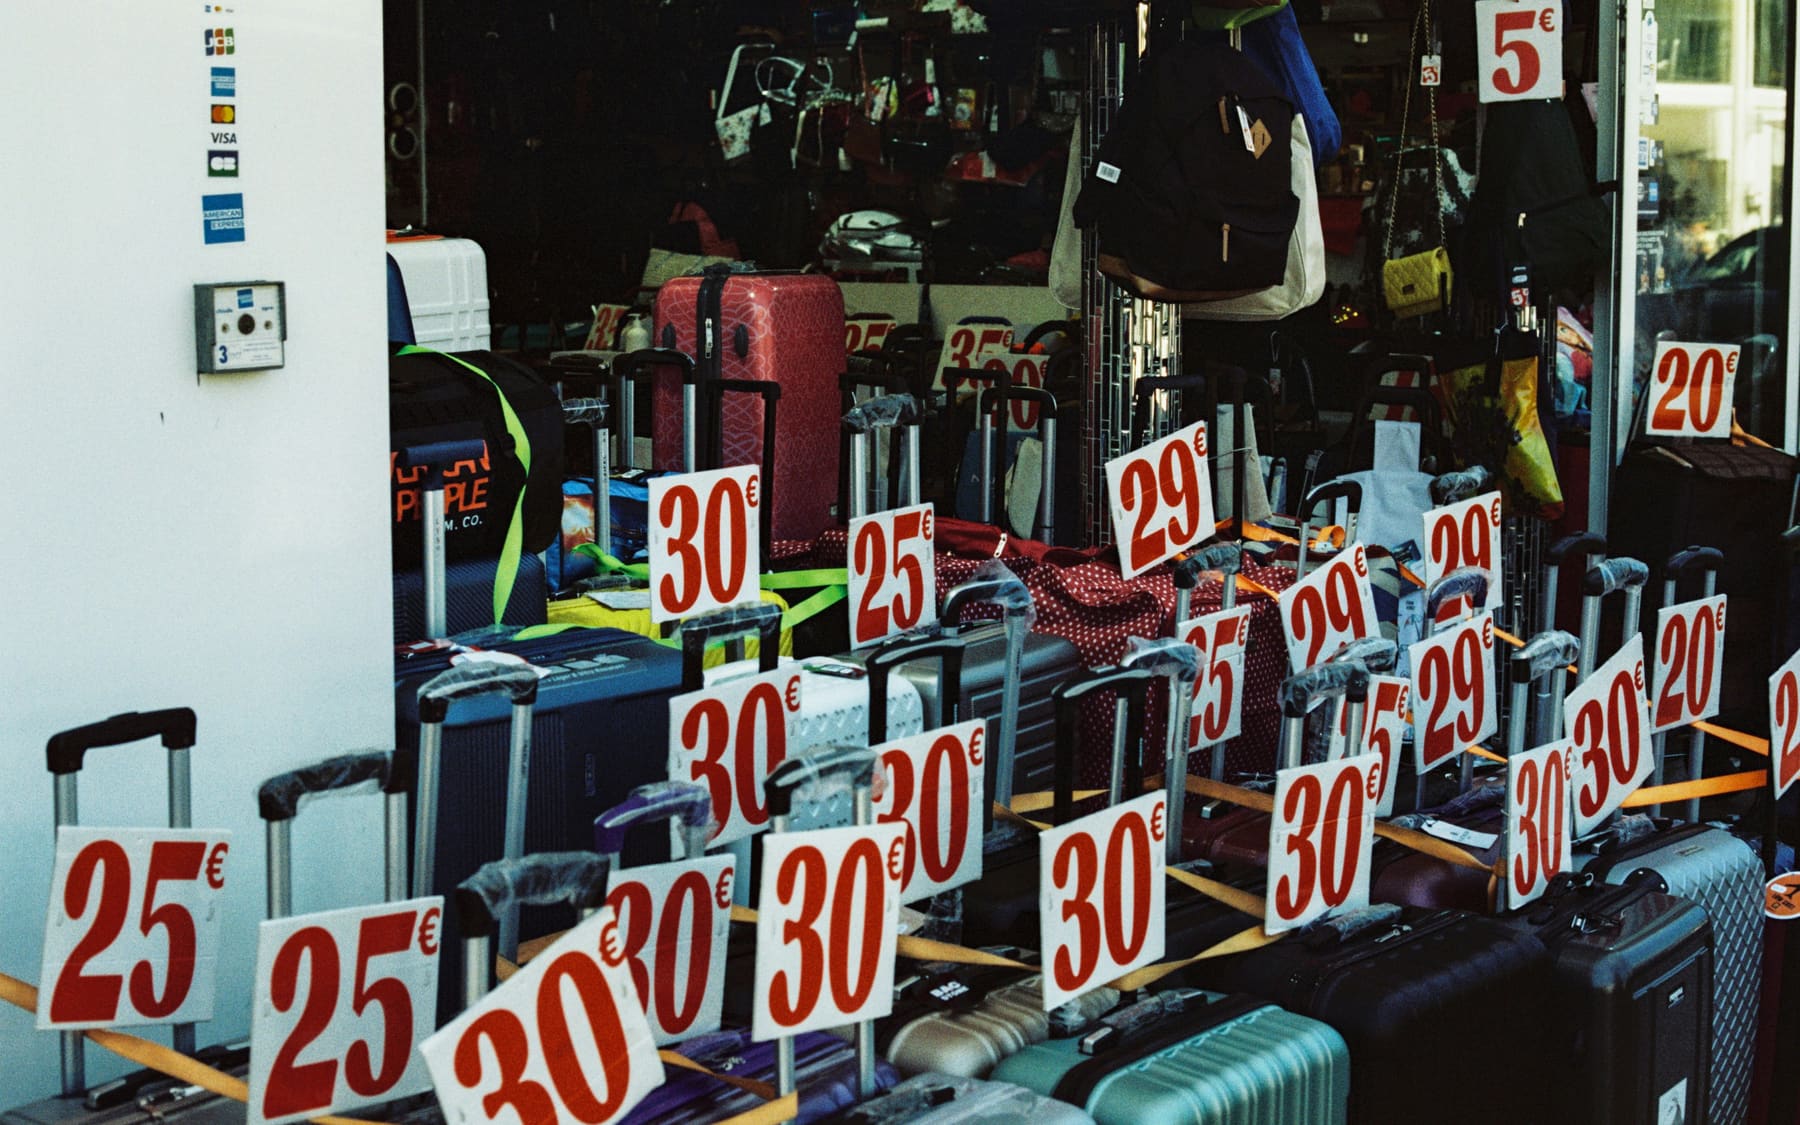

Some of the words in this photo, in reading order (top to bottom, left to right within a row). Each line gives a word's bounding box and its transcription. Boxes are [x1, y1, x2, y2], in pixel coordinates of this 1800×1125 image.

[205, 36, 234, 47] JCB
[1491, 8, 1555, 95] 5€
[211, 132, 237, 144] VISA
[204, 209, 242, 220] AMERICAN
[211, 219, 244, 230] EXPRESS
[219, 345, 228, 364] 3
[1651, 347, 1738, 433] 20€
[462, 515, 483, 527] CO.
[659, 475, 760, 614] 30€
[1120, 426, 1207, 571] 29€
[854, 507, 933, 643] 25€
[1418, 616, 1493, 767] 29€
[1655, 602, 1726, 728] 20€
[681, 675, 801, 838] 30€
[1573, 660, 1643, 819] 30€
[1275, 761, 1381, 920] 30€
[1514, 745, 1574, 897] 30€
[50, 840, 230, 1024] 25€
[768, 834, 905, 1028] 30€
[1052, 800, 1166, 992] 30€
[263, 906, 442, 1120] 25€
[453, 919, 627, 1125] 30€
